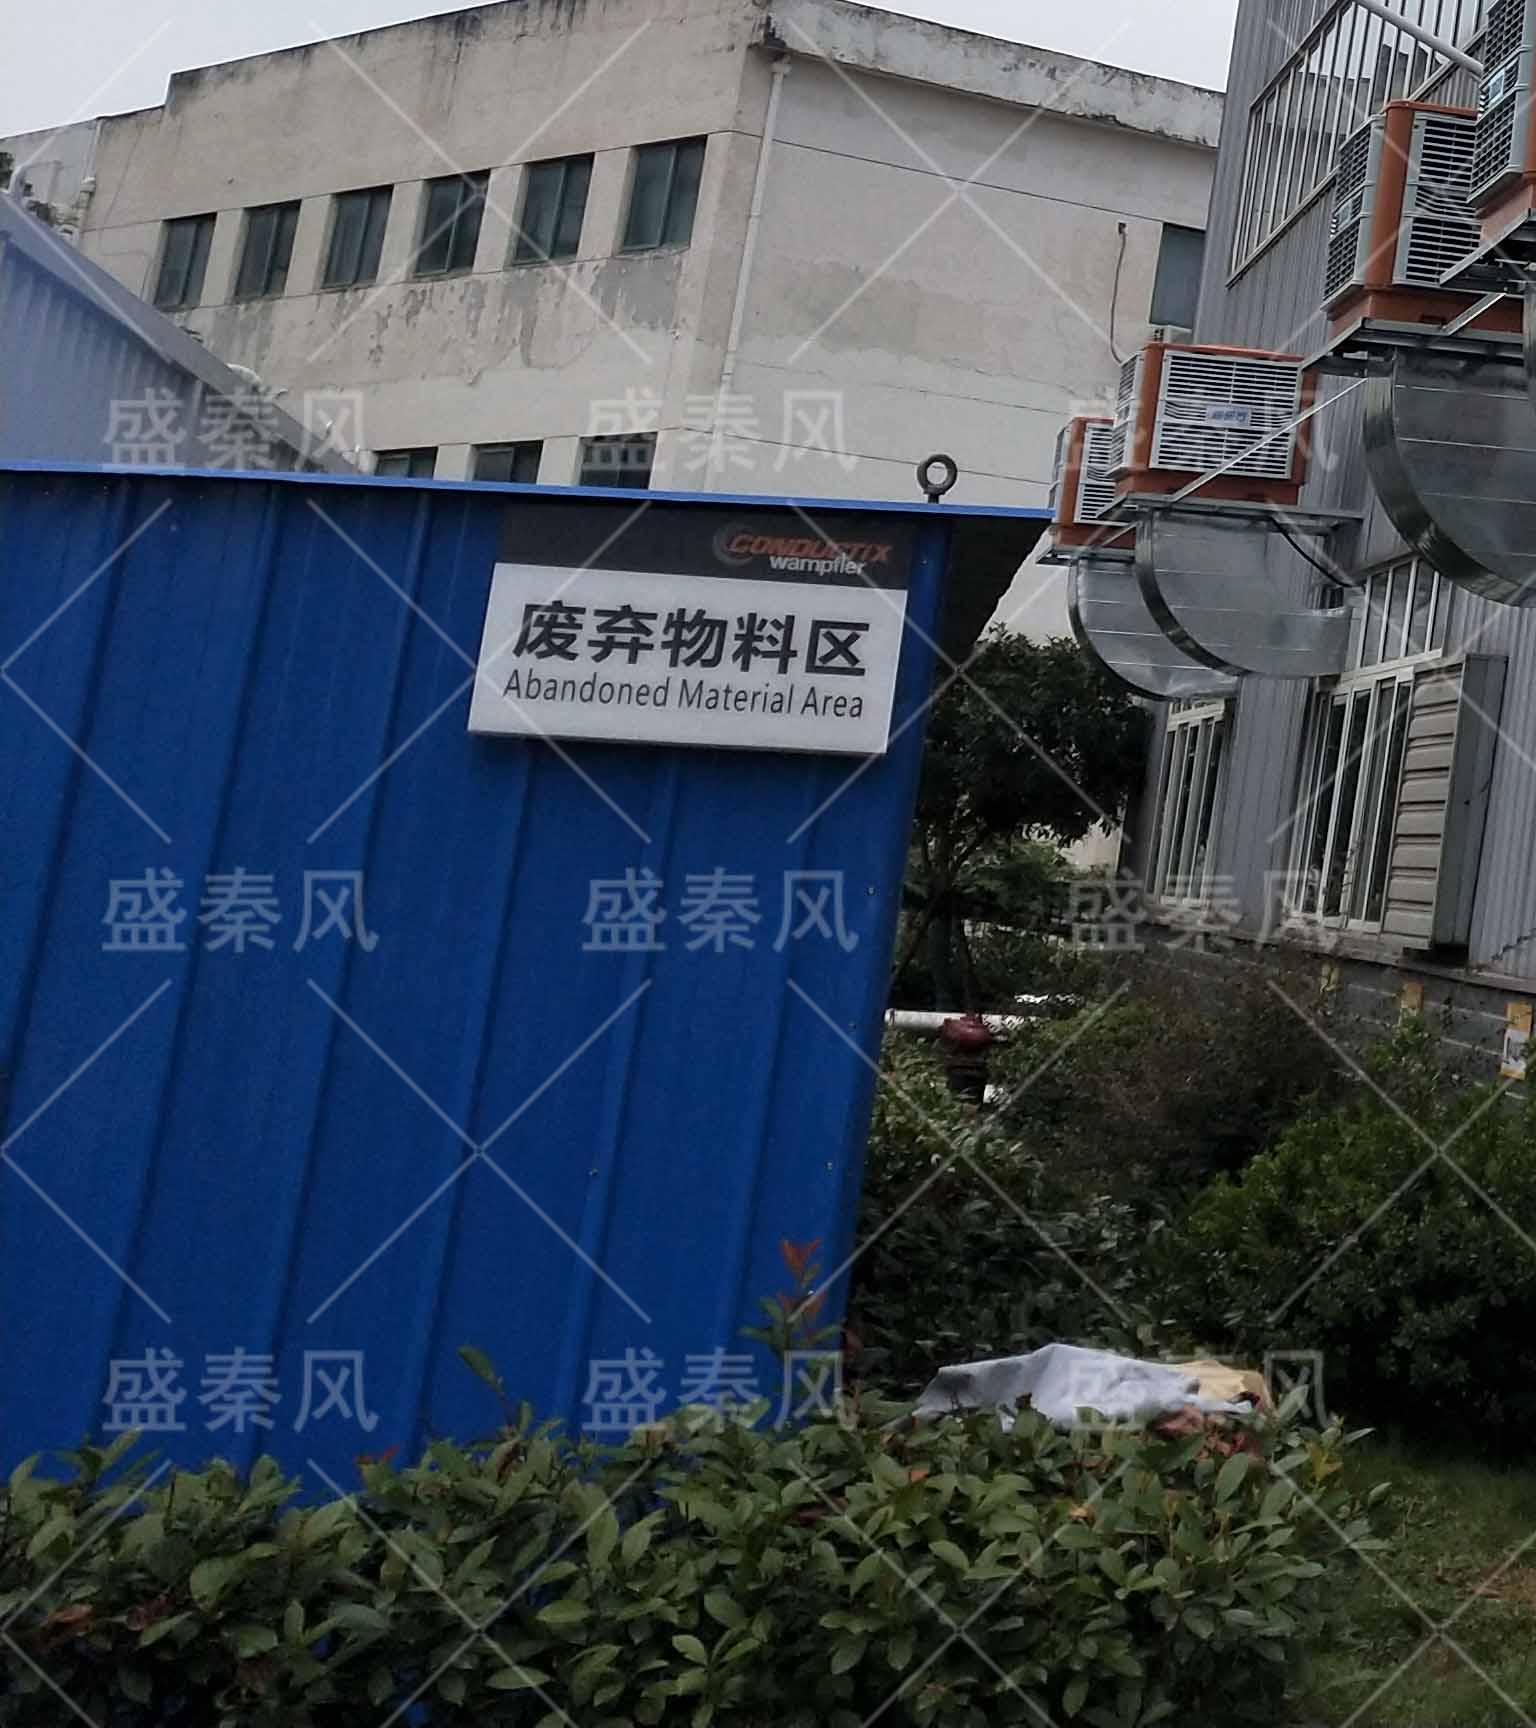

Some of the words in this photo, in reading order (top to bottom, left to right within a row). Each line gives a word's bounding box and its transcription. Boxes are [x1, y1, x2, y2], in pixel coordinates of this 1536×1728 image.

[769, 552, 866, 576] wampfler
[512, 600, 870, 677] 废弃物料区
[503, 669, 671, 708] Abandoned
[678, 678, 795, 715] Material
[800, 685, 865, 719] Area
